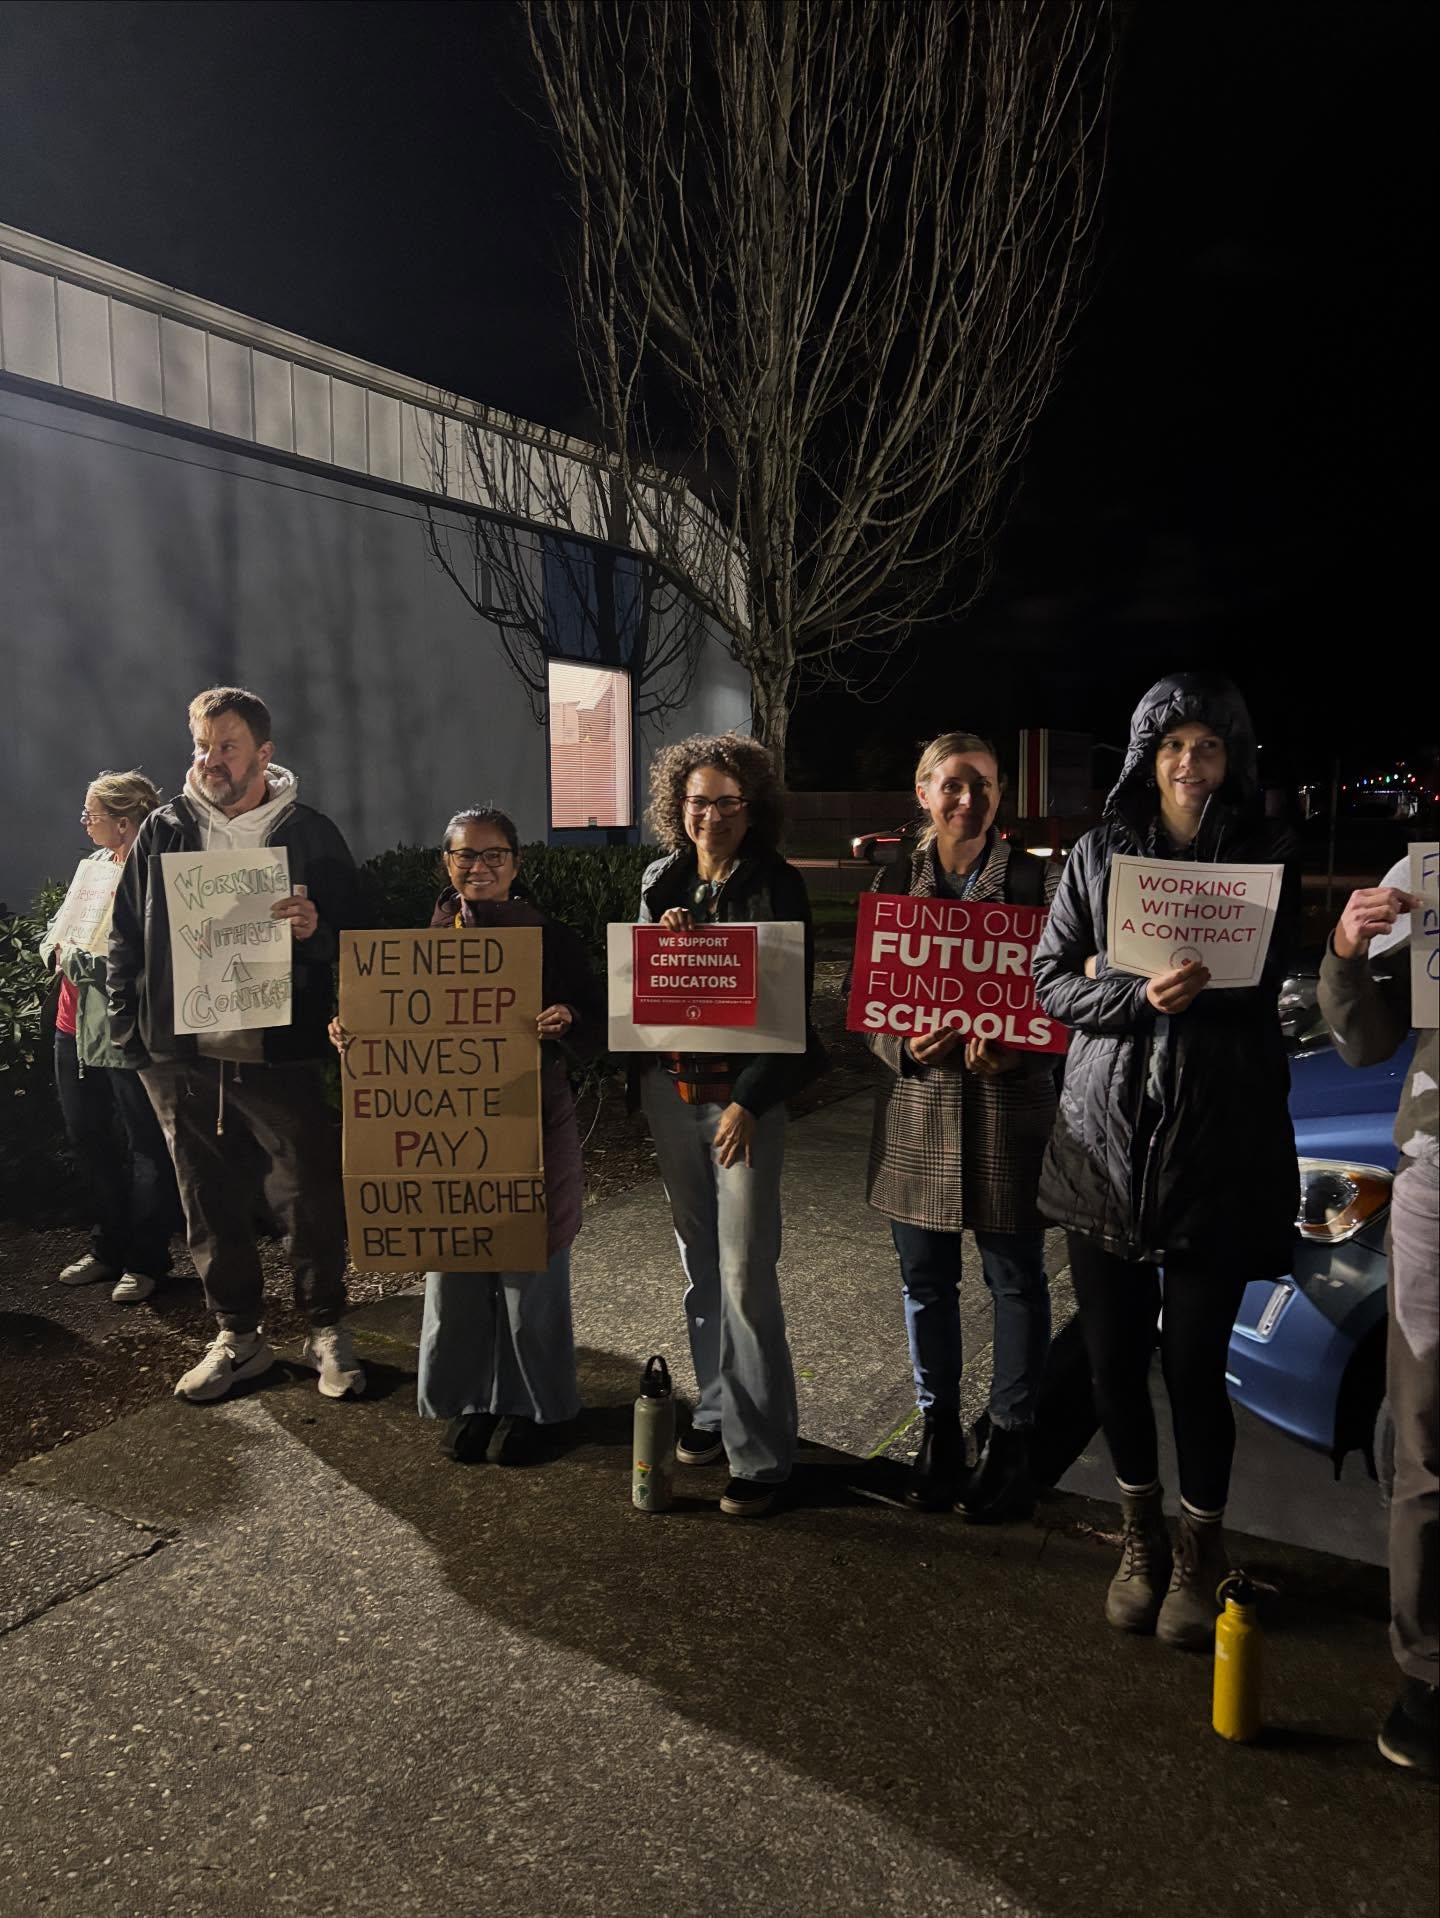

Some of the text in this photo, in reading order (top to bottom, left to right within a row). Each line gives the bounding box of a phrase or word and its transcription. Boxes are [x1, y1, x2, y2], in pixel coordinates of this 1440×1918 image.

[174, 864, 289, 911] WORKING
[1138, 874, 1247, 897] WORKING
[874, 902, 971, 932] FUND
[1141, 898, 1245, 920] WITHOUT
[179, 916, 289, 961] WITHOUT
[658, 937, 729, 948] WE SUPPORT
[1121, 918, 1257, 943] A CONTRACT
[221, 953, 253, 983] A
[353, 938, 504, 976] WE NEED
[650, 953, 741, 967] CENTENNIAL
[870, 931, 1037, 977] FUTUR
[650, 975, 737, 989] EDUCATORS
[868, 970, 1039, 1011] FUND OU
[380, 987, 516, 1025] TO IEP
[863, 1001, 1052, 1046] SCHOOLS
[344, 1036, 507, 1080] (INVEST
[354, 1087, 500, 1118] EDUCATE
[395, 1126, 488, 1169] PAY)
[360, 1179, 546, 1215] OUR TEACHER
[363, 1227, 493, 1257] BETTER
